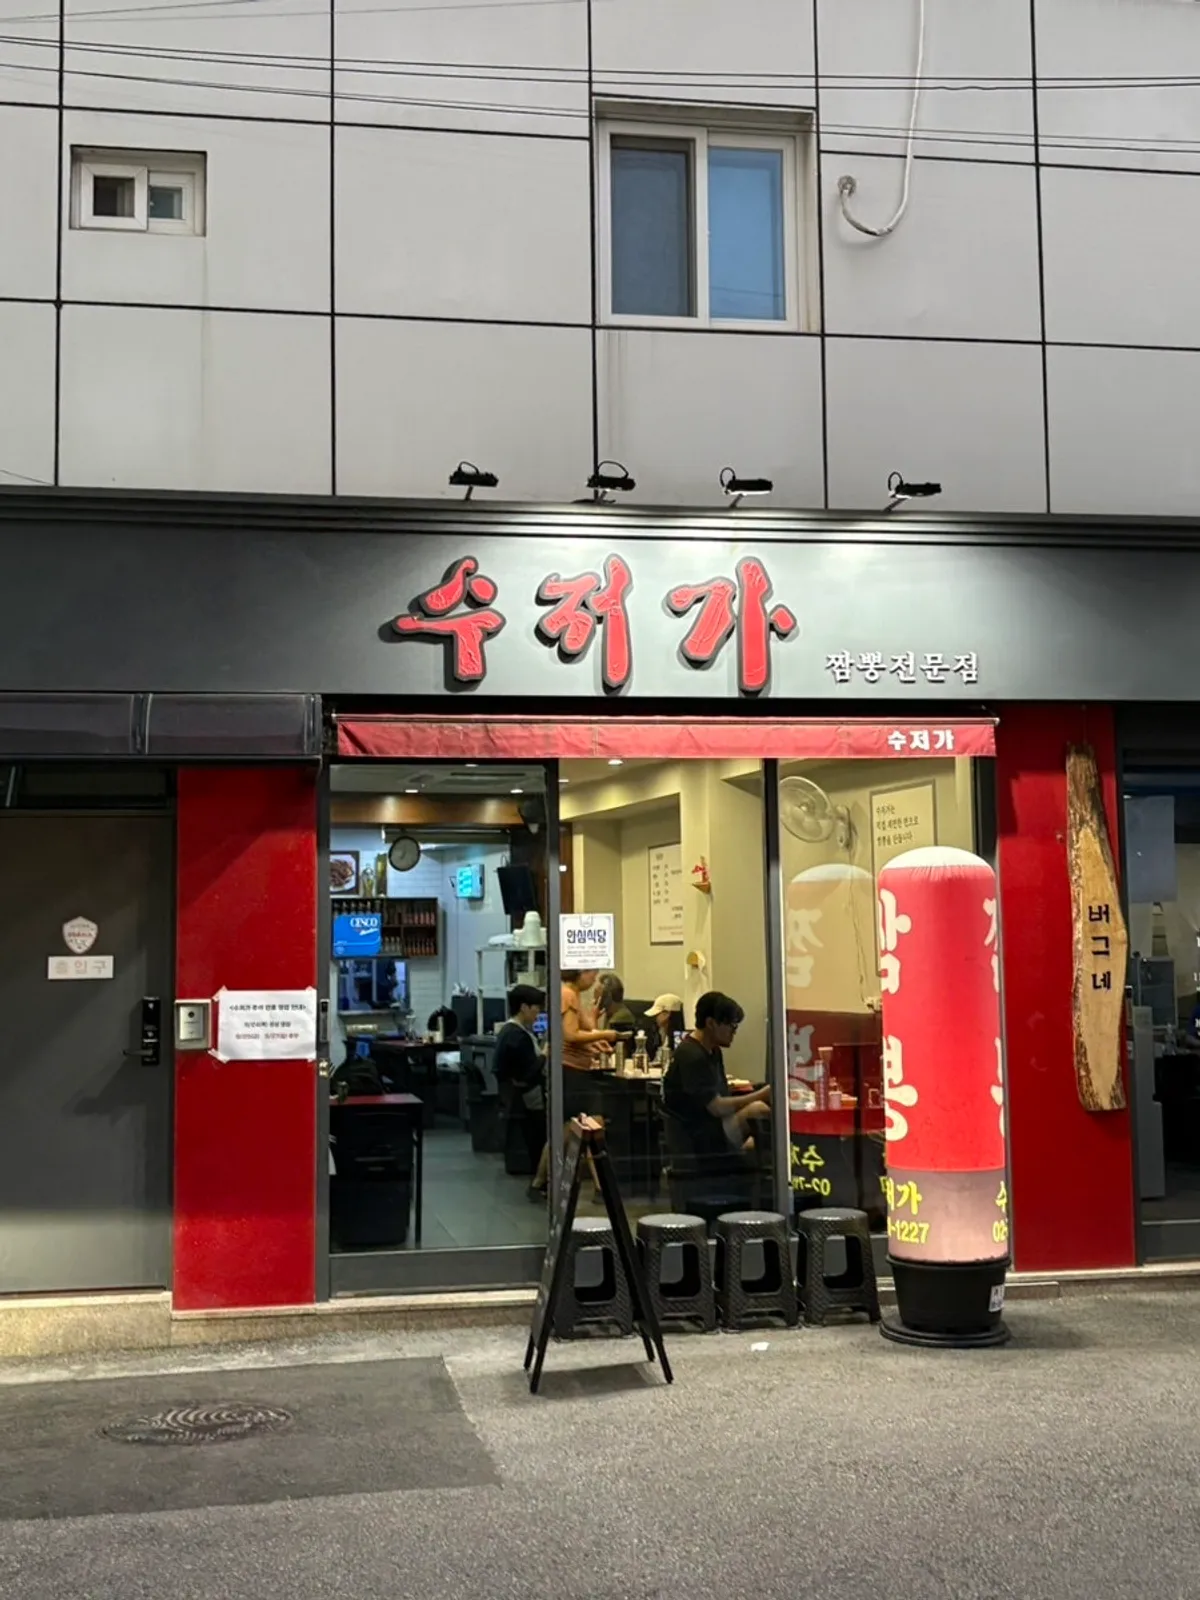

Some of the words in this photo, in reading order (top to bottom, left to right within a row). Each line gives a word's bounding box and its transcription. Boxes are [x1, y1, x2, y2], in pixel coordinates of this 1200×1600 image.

[391, 553, 797, 692] 수저가
[825, 650, 979, 684] 짬뽕전문점
[887, 729, 955, 751] 수저가
[566, 929, 607, 943] 안심식당
[1088, 904, 1111, 990] 버그네
